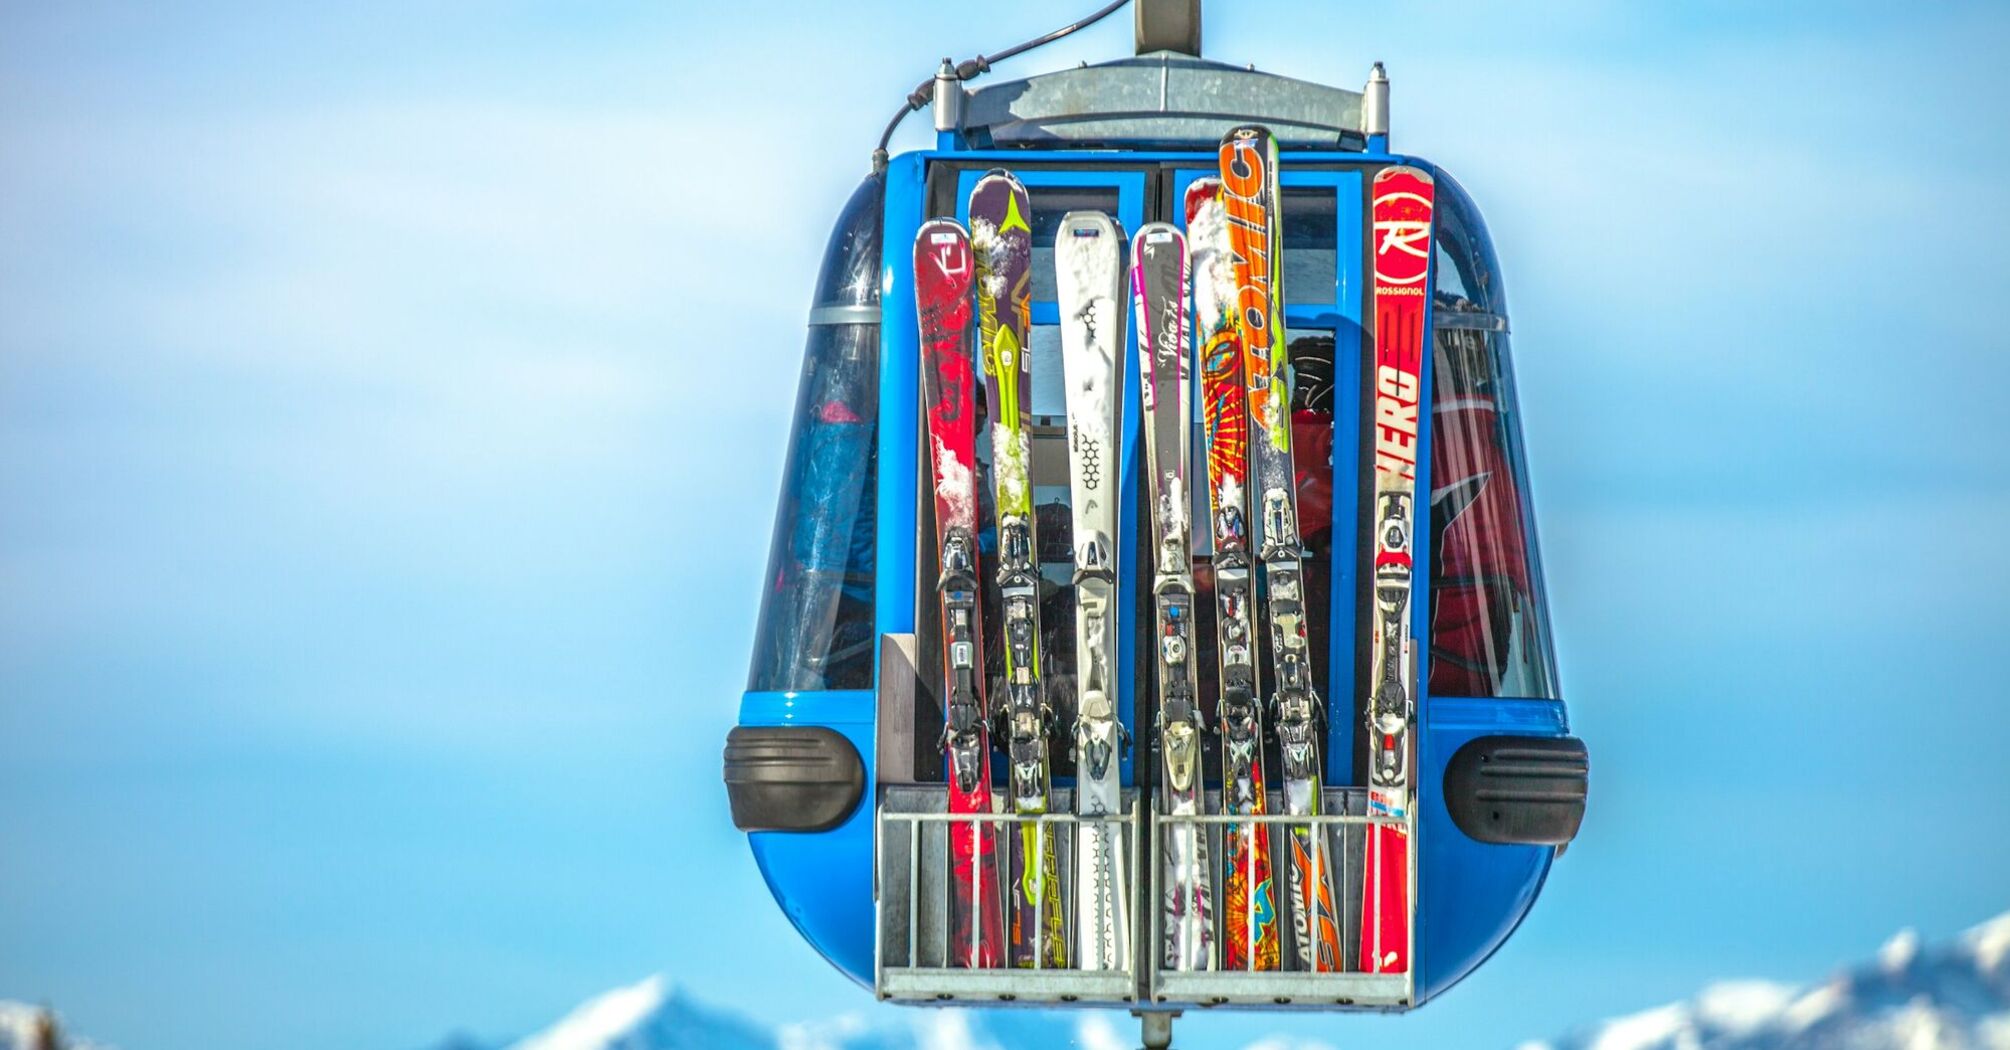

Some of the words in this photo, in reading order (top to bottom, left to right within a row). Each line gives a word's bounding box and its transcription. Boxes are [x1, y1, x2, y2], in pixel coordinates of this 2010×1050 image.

[1220, 142, 1269, 430] ATOMIC
[1375, 286, 1424, 296] ROSSIGNOL
[1376, 364, 1418, 484] HERO
[1290, 863, 1311, 963] ATOMIC
